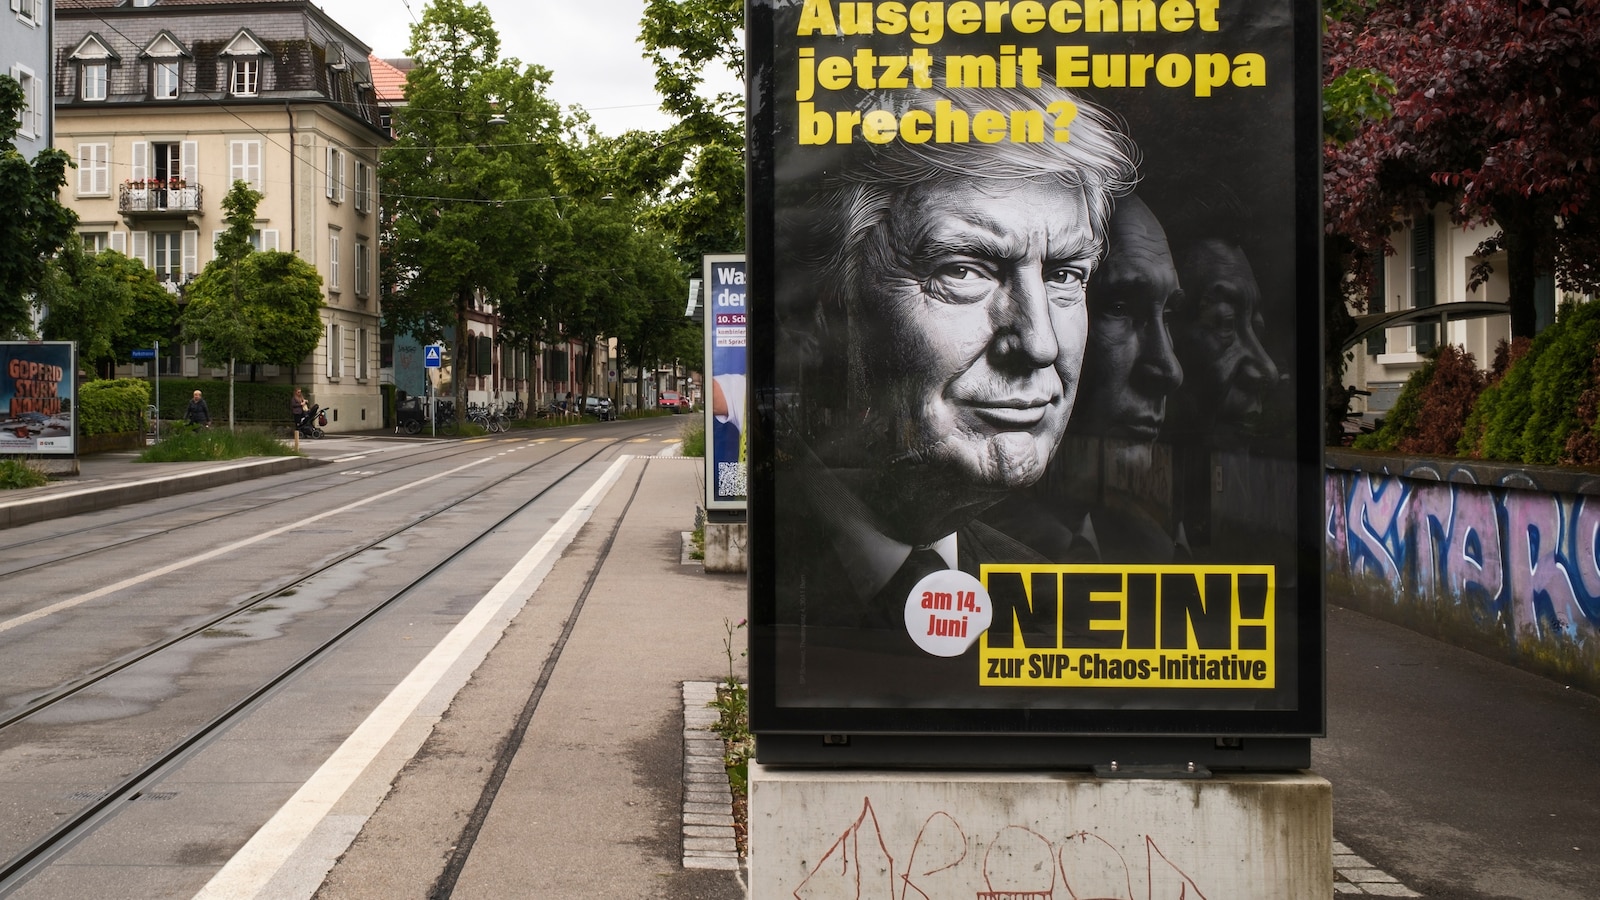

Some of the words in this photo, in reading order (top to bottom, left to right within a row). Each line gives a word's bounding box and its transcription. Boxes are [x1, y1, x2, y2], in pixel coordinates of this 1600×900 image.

[797, 0, 1220, 45] Ausgerechnet
[796, 47, 933, 101] jetzt
[946, 45, 1042, 89] mit
[1056, 46, 1266, 97] Europa
[799, 100, 1078, 145] brechen?
[717, 315, 730, 323] 10.
[9, 358, 63, 382] GOPFRID
[15, 379, 58, 398] STURM
[921, 591, 952, 611] am
[957, 591, 981, 613] 14.
[987, 572, 1268, 651] NEIN!
[927, 614, 968, 638] Juni
[987, 658, 1025, 679] zur
[1028, 653, 1267, 681] SVP-Chaos-Initiative
